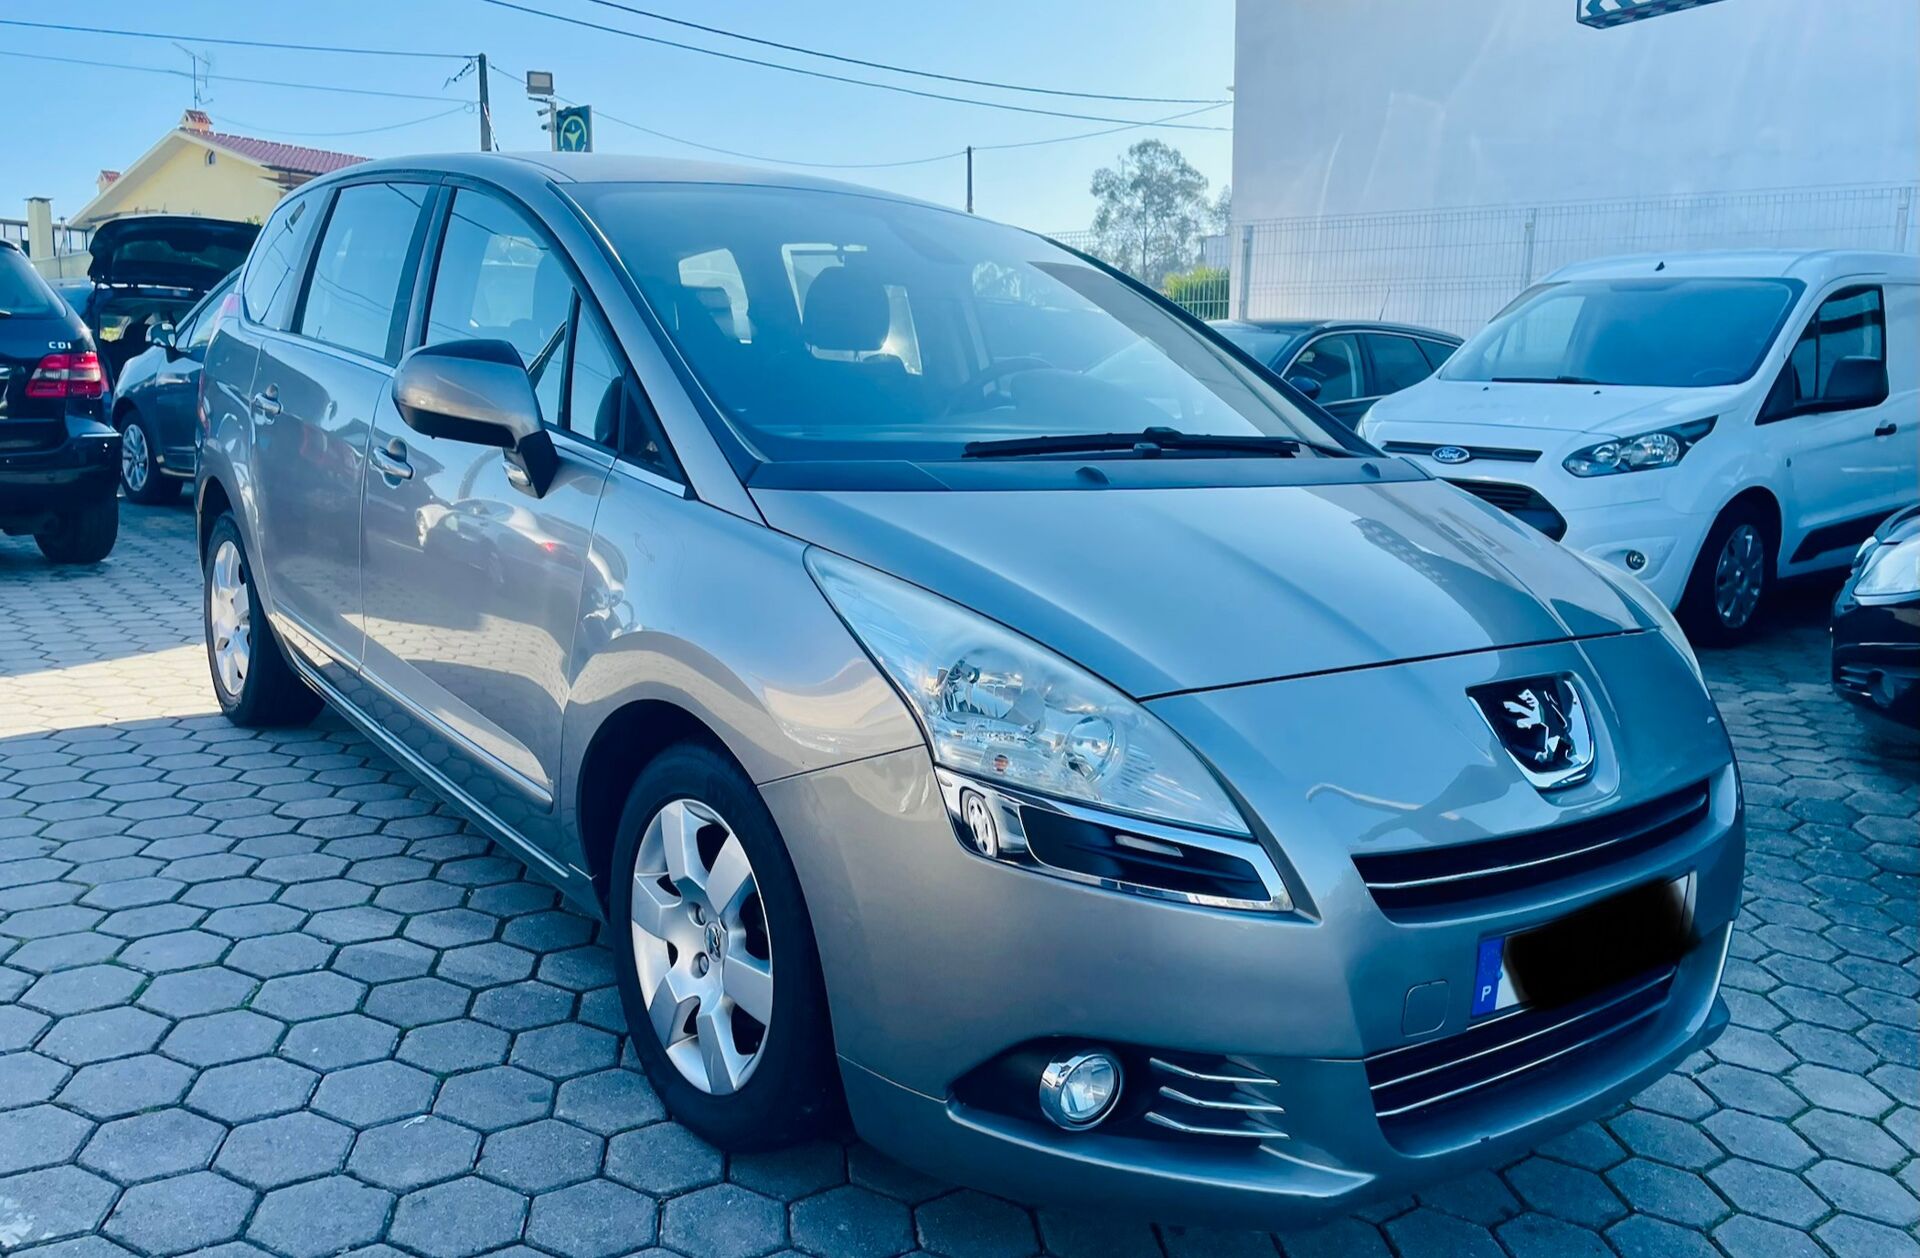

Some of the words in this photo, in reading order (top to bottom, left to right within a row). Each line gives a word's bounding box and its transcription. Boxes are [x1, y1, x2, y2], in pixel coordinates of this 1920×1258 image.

[48, 341, 72, 350] CDI
[1438, 447, 1461, 459] Ford
[1480, 984, 1492, 1002] P
